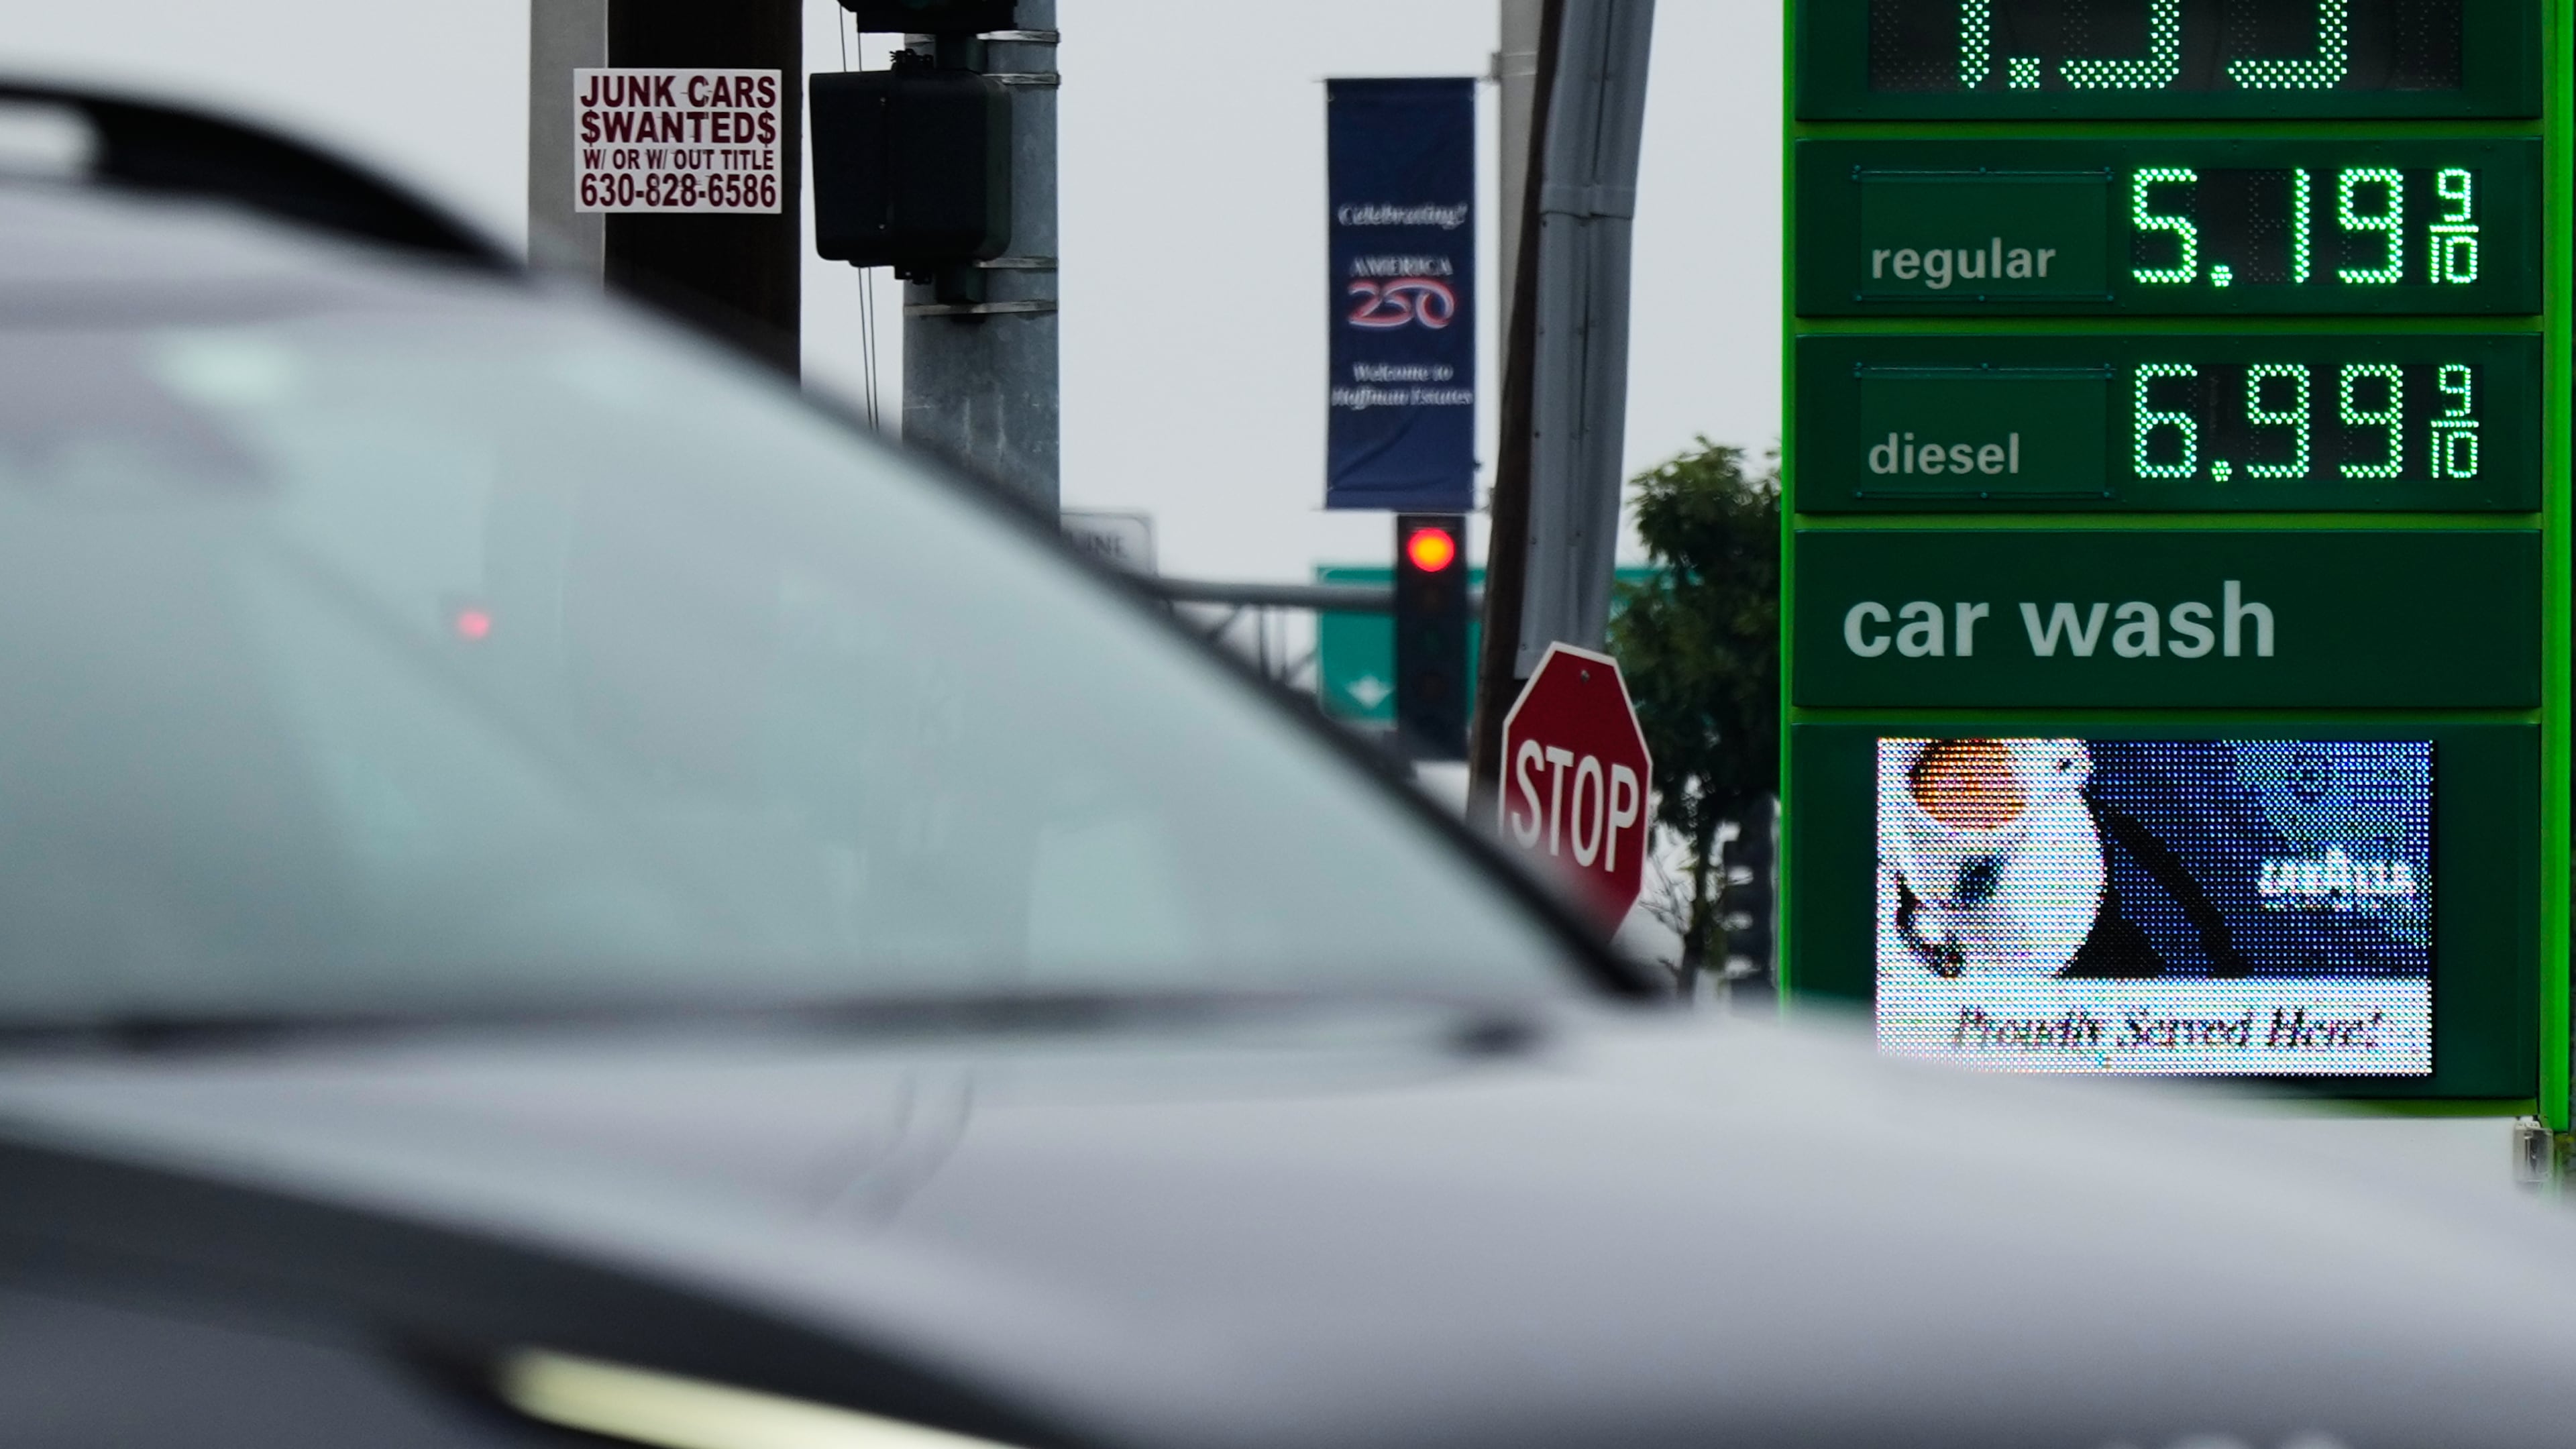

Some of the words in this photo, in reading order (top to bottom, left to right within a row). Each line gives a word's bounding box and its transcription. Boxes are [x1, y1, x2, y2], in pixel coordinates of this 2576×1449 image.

[580, 75, 676, 108] JUNK
[687, 75, 776, 109] CARS
[580, 109, 776, 148] $WANTED$
[612, 149, 641, 170] OR
[720, 149, 773, 170] TITLE
[581, 172, 776, 208] 630-828-6586
[2132, 168, 2404, 287] 5.19
[1350, 255, 1453, 276] AMERICA
[1872, 237, 2056, 290] regular
[1348, 276, 1457, 329] 250
[1352, 364, 1429, 382] Welcome
[1432, 366, 1454, 382] to
[1331, 386, 1408, 410] Hoffman
[1411, 388, 1473, 405] Estates
[2133, 364, 2404, 482] 6.99
[1868, 432, 2019, 474] diesel
[1843, 600, 1989, 658] car
[2019, 580, 2274, 658] wash
[1511, 739, 1640, 872] STOP
[2116, 1005, 2252, 1049] Served
